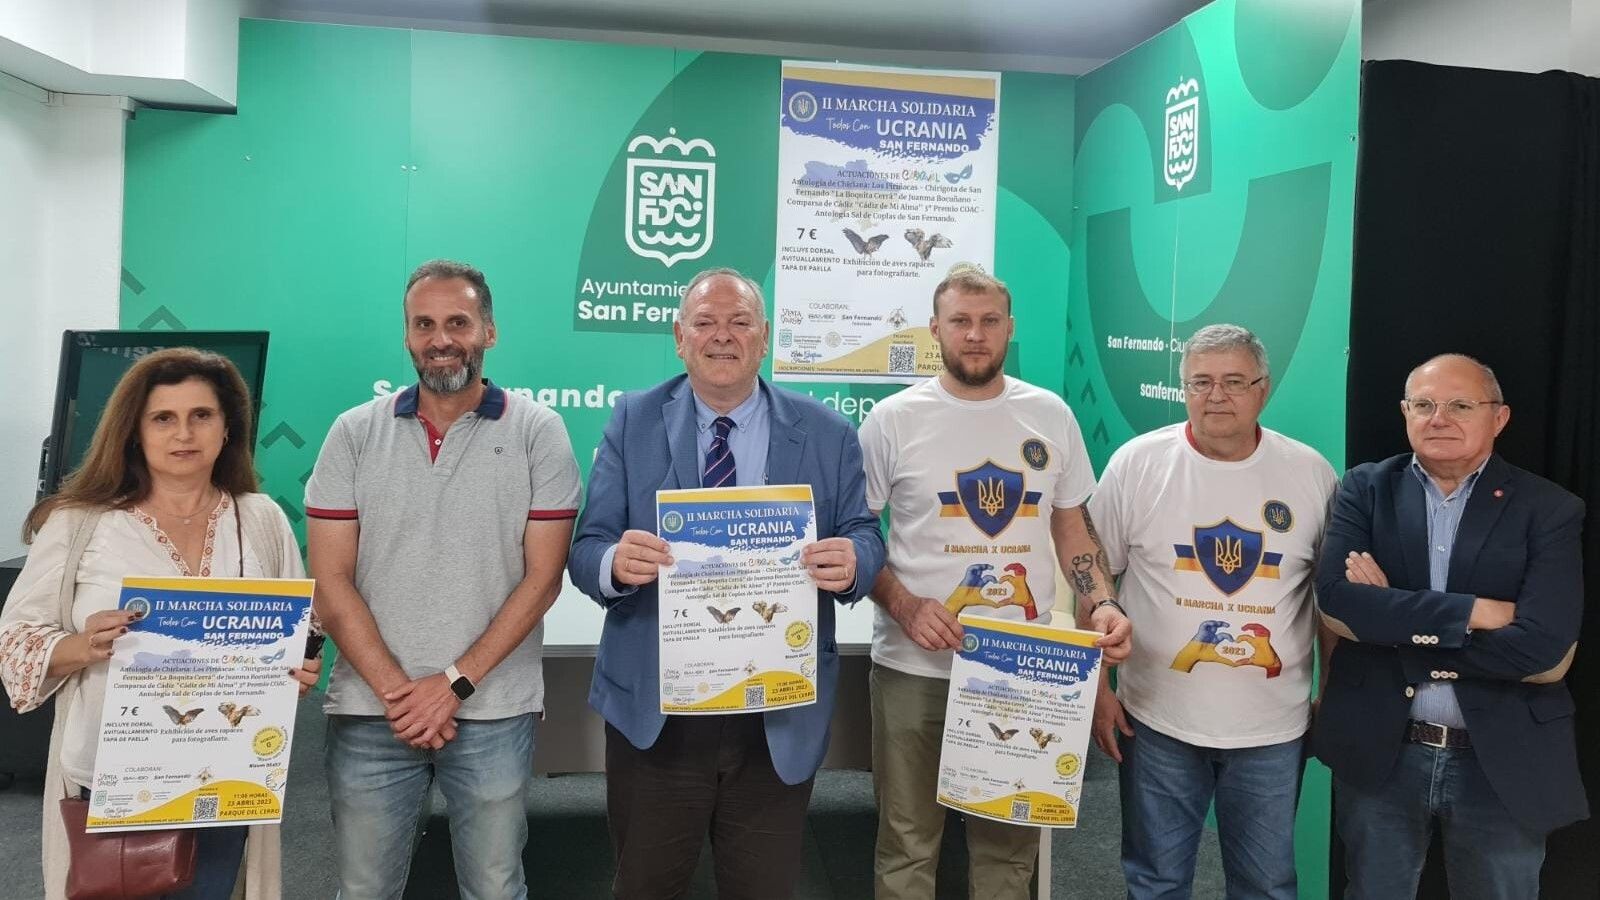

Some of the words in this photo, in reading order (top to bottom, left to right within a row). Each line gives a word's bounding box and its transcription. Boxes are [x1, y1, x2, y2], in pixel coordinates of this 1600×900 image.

[822, 97, 832, 110] II
[836, 98, 898, 113] MARCHA
[901, 101, 976, 117] SOLIDARIA
[826, 117, 850, 131] Todos
[852, 118, 870, 132] Con
[1169, 109, 1193, 136] SAN
[876, 119, 967, 140] UCRANIA
[880, 140, 903, 151] SAN
[907, 141, 969, 152] FERNANDO
[837, 170, 888, 179] ACTUACIONES
[890, 172, 900, 180] DE
[639, 171, 703, 199] SAN
[925, 184, 957, 194] Chirigota
[796, 188, 829, 196] Fernando
[787, 198, 822, 207] Comparsa
[833, 200, 853, 208] Cádiz
[873, 212, 896, 220] Coplas
[797, 227, 805, 239] 7
[809, 228, 817, 240] €
[781, 255, 840, 263] AVITUALLAMIENTO
[578, 300, 627, 321] San
[1107, 335, 1122, 349] San
[1123, 336, 1164, 351] Fernando
[687, 512, 694, 522] II
[696, 509, 742, 521] MARCHA
[744, 506, 800, 519] SOLIDARIA
[727, 520, 795, 537] UCRANIA
[730, 538, 748, 546] SAN
[750, 535, 797, 545] FERNANDO
[155, 600, 164, 611] II
[168, 600, 223, 611] MARCHA
[226, 601, 293, 611] SOLIDARIA
[1184, 598, 1224, 611] MARCHA
[1227, 603, 1234, 612] X
[673, 609, 679, 618] 7
[682, 608, 688, 618] €
[202, 615, 283, 630] UCRANIA
[203, 632, 225, 640] SAN
[228, 632, 284, 640] FERNANDO
[982, 638, 989, 646] II
[991, 639, 1033, 653] MARCHA
[1035, 644, 1087, 660] SOLIDARIA
[1222, 646, 1246, 655] 2023
[1017, 655, 1079, 674] UCRANIA
[1018, 668, 1035, 676] SAN
[1036, 671, 1080, 682] FERNANDO
[120, 706, 128, 716] 7
[131, 706, 139, 716] €
[958, 717, 964, 726] 7
[966, 719, 971, 727] €
